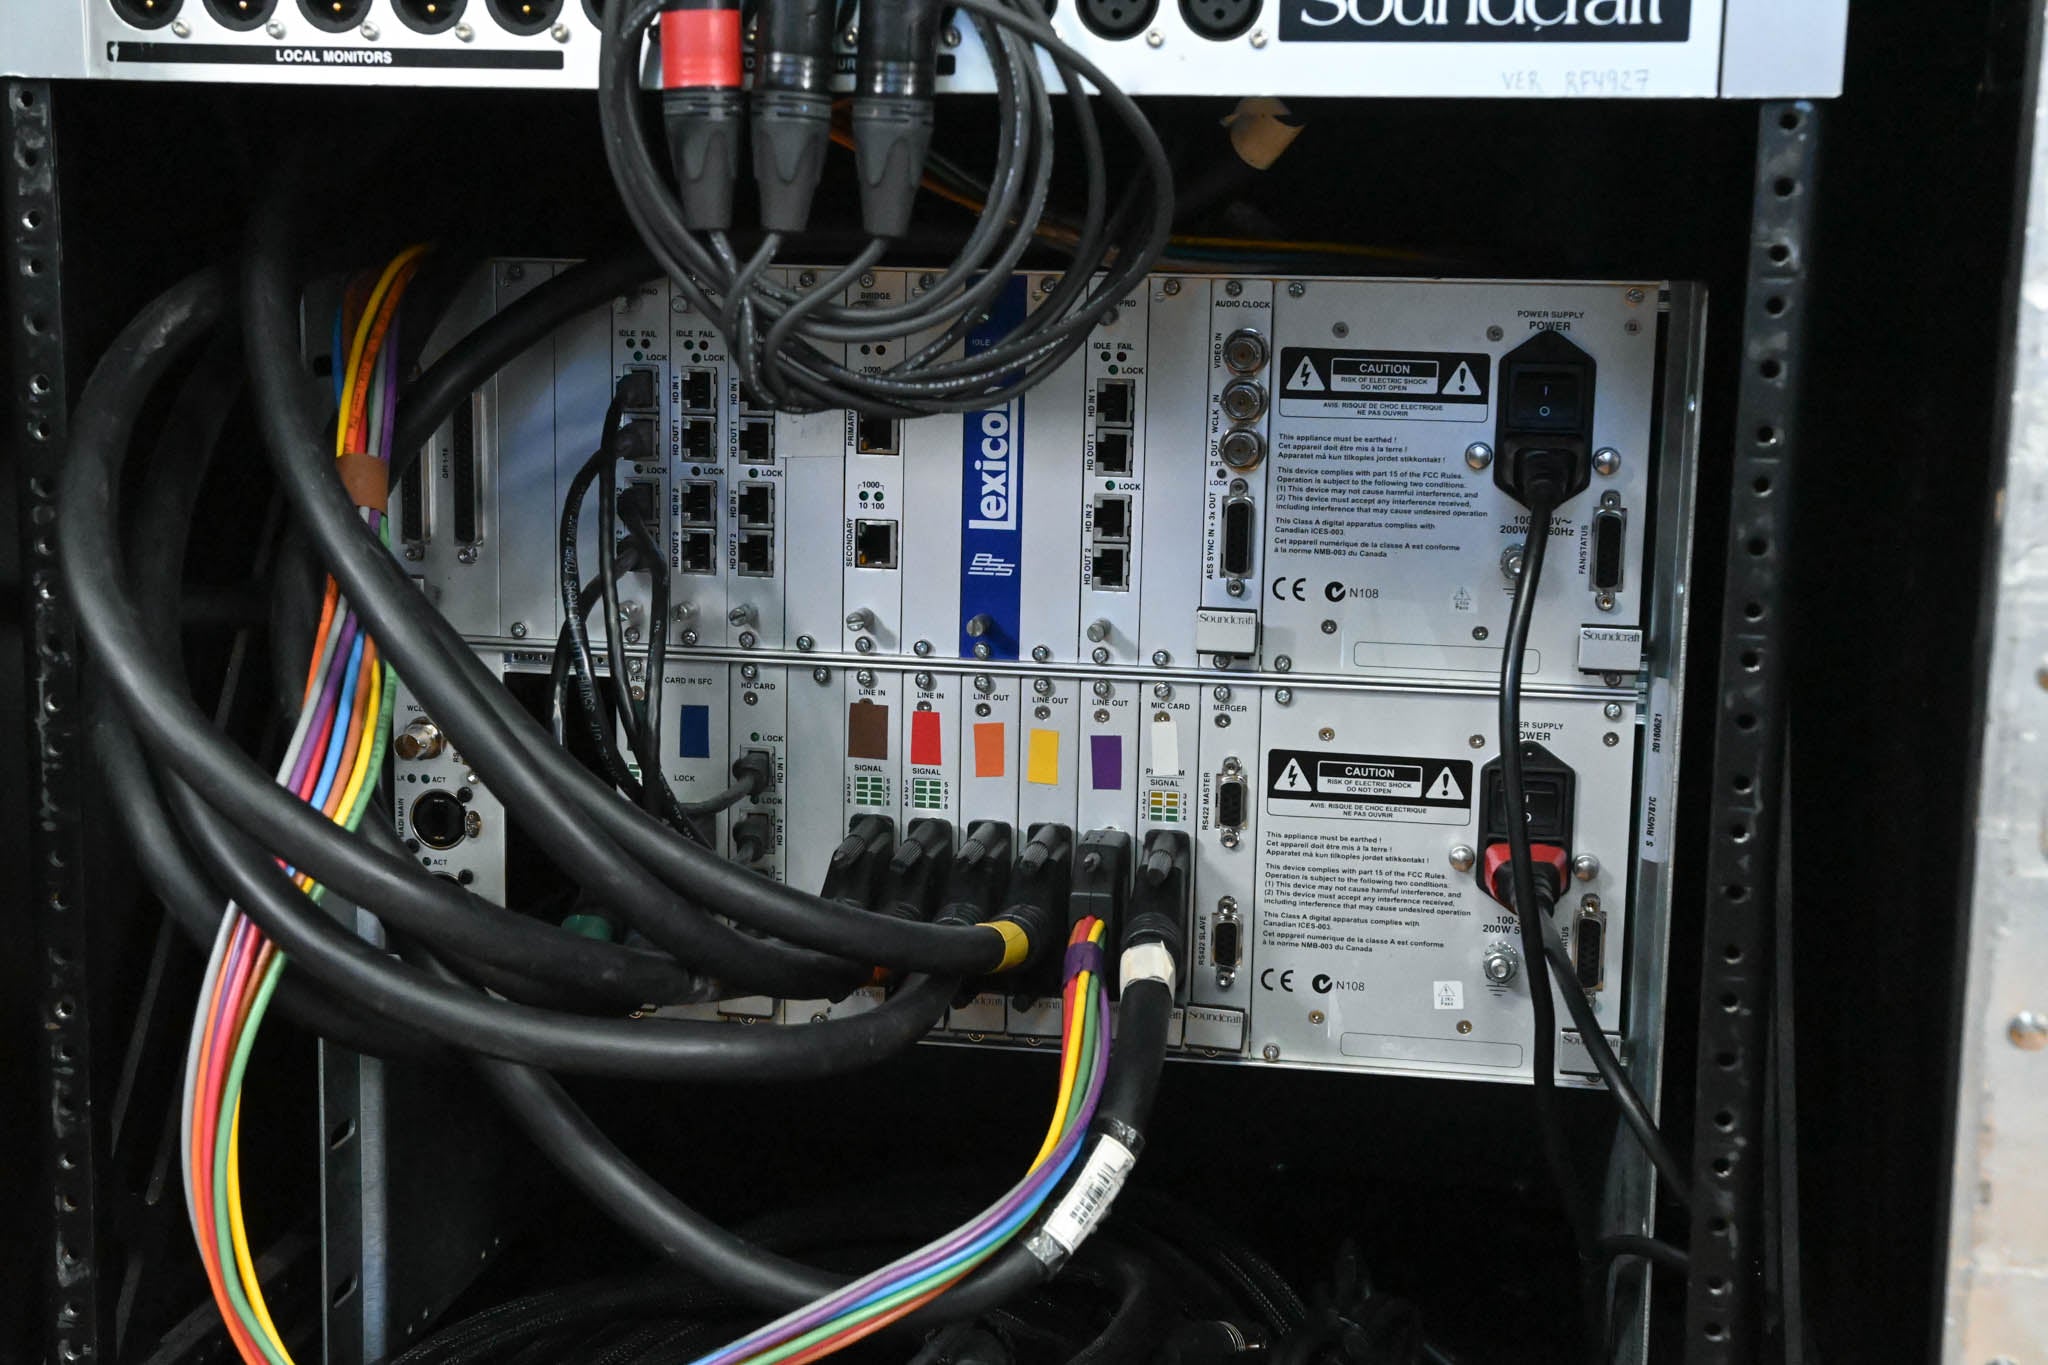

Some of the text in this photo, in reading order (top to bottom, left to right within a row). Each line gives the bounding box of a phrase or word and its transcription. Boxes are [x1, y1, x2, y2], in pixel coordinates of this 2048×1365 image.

[275, 49, 392, 65] LOCAL MONITORS
[861, 292, 891, 300] BRIDGE
[1517, 310, 1584, 320] POWER SUPPLY
[1529, 321, 1571, 332] POWER
[1214, 343, 1222, 368] VIDEO
[1359, 363, 1411, 375] CAUTION
[1088, 405, 1095, 417] HD
[1212, 409, 1220, 433] WCLK
[848, 410, 856, 447] PRIMARY
[1087, 458, 1094, 471] HD
[862, 481, 880, 489] 1000
[1119, 483, 1141, 491] LOCK
[1085, 520, 1092, 532] HD
[846, 518, 855, 568] SECONDARY
[1579, 524, 1589, 575] FAN/STATUS
[1084, 573, 1091, 585] HD
[1350, 588, 1380, 599] N108
[1199, 613, 1254, 626] Soundcraft
[1582, 630, 1640, 643] Soundcraft
[664, 676, 687, 685] CARD
[688, 677, 696, 685] IN
[754, 683, 776, 691] CARD
[937, 692, 945, 700] IN
[973, 693, 1010, 702] LINE OUT
[1112, 699, 1129, 707] OUT
[1151, 702, 1190, 711] MIC CARD
[1213, 704, 1248, 712] MERGER
[1531, 722, 1564, 730] SUPPLY
[1519, 731, 1552, 741] OWER
[854, 765, 883, 773] SIGNAL
[912, 767, 941, 776] SIGNAL
[1345, 766, 1395, 778] CAUTION
[674, 775, 695, 783] LOCK
[1150, 779, 1180, 787] SIGNAL
[1354, 780, 1387, 788] ELECTRIC
[1388, 781, 1412, 789] SHOCK
[1203, 772, 1211, 806] MASTER
[1328, 802, 1353, 810] RISQUE
[1365, 804, 1384, 812] CHOC
[1385, 805, 1427, 814] ELECTRIQUE
[1368, 811, 1393, 819] OUVRIR
[1282, 863, 1305, 871] device
[1358, 868, 1372, 877] part
[1424, 872, 1446, 880] Rules.
[1199, 915, 1207, 941] SLAVE
[1483, 924, 1511, 934] 200W
[1300, 941, 1332, 949] NMB-003
[1345, 943, 1372, 951] Canada
[1337, 981, 1365, 992] N108
[1189, 1011, 1242, 1024] Soundcraft
